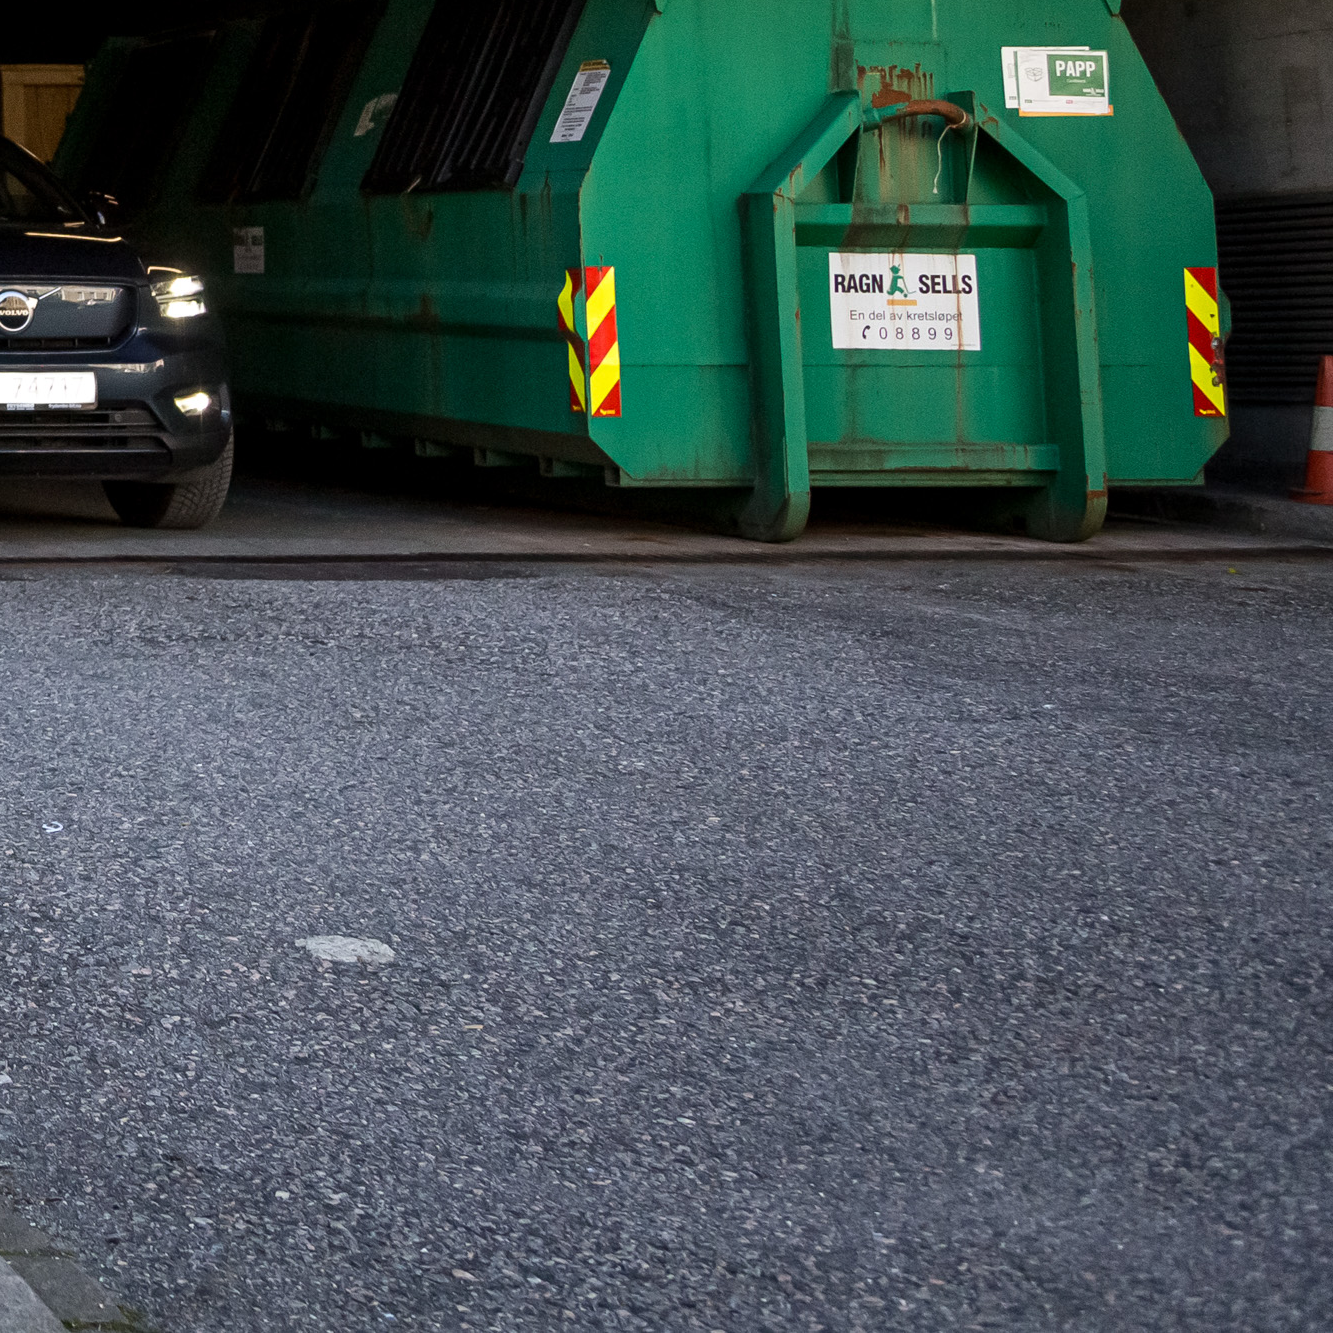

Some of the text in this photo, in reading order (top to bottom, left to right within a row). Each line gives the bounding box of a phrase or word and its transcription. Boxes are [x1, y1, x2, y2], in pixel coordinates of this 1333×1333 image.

[1055, 60, 1095, 77] PAPP
[834, 274, 973, 294] RAGN SELLS
[850, 310, 963, 323] En del av kretsløpet
